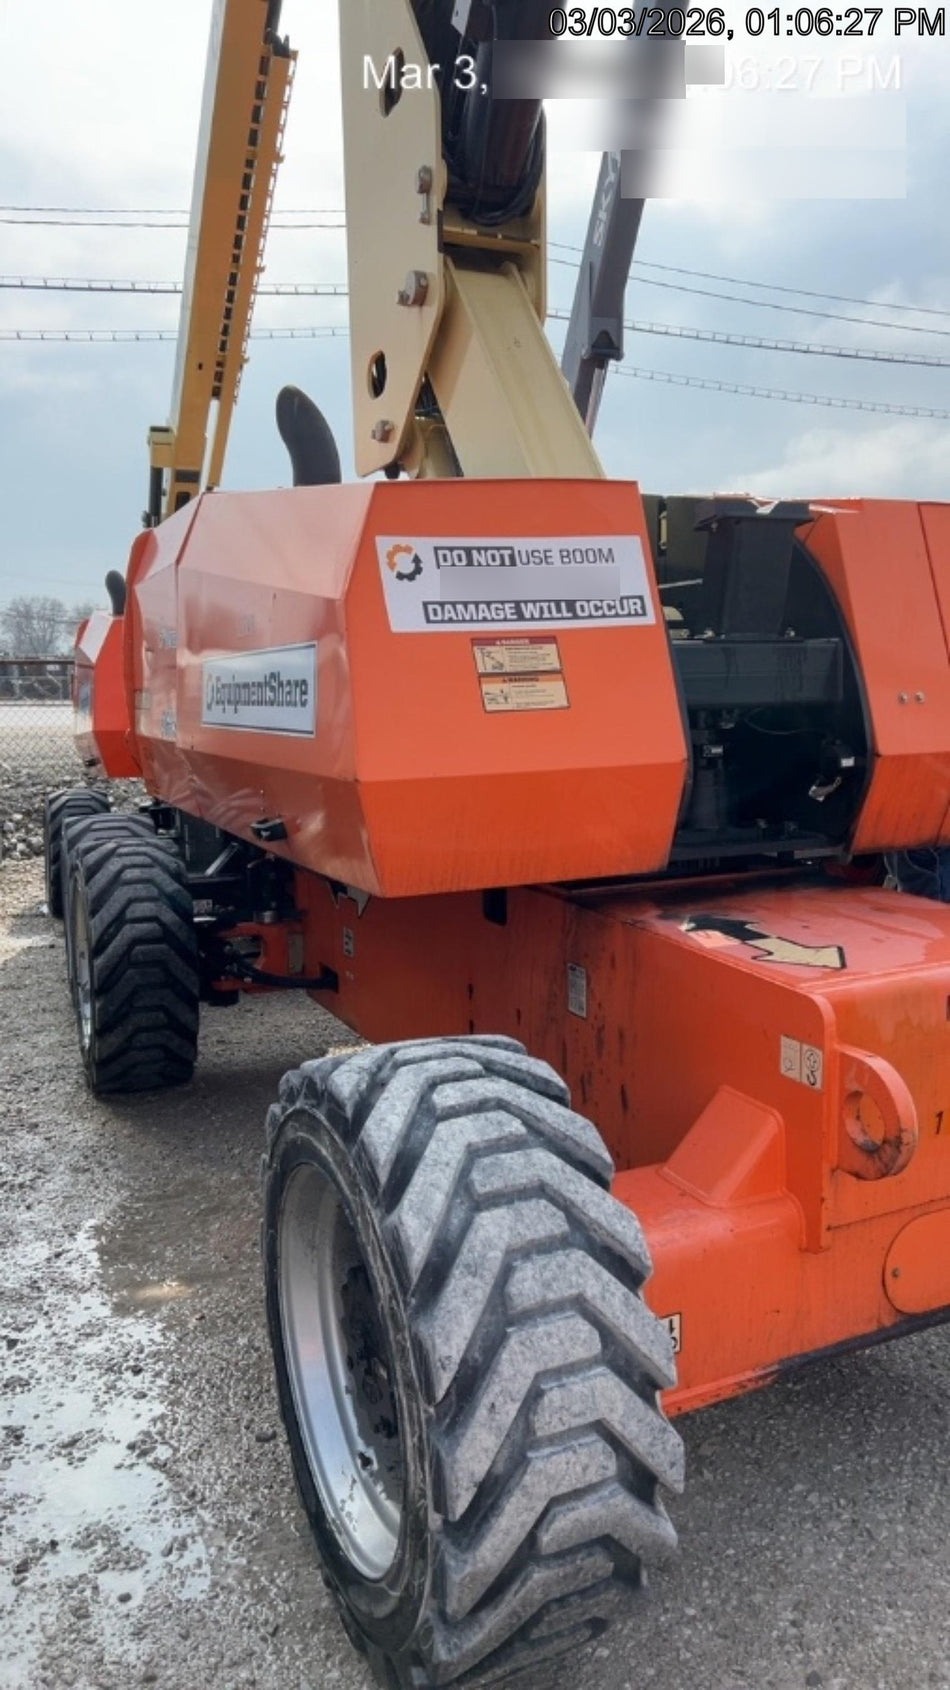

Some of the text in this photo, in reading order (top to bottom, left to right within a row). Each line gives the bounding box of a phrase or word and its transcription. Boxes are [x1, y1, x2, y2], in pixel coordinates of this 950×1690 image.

[438, 548, 616, 567] DO NOT USE BOOM
[427, 598, 643, 622] DAMAGE WILL OCCUR
[215, 672, 308, 714] EquipmentShare
